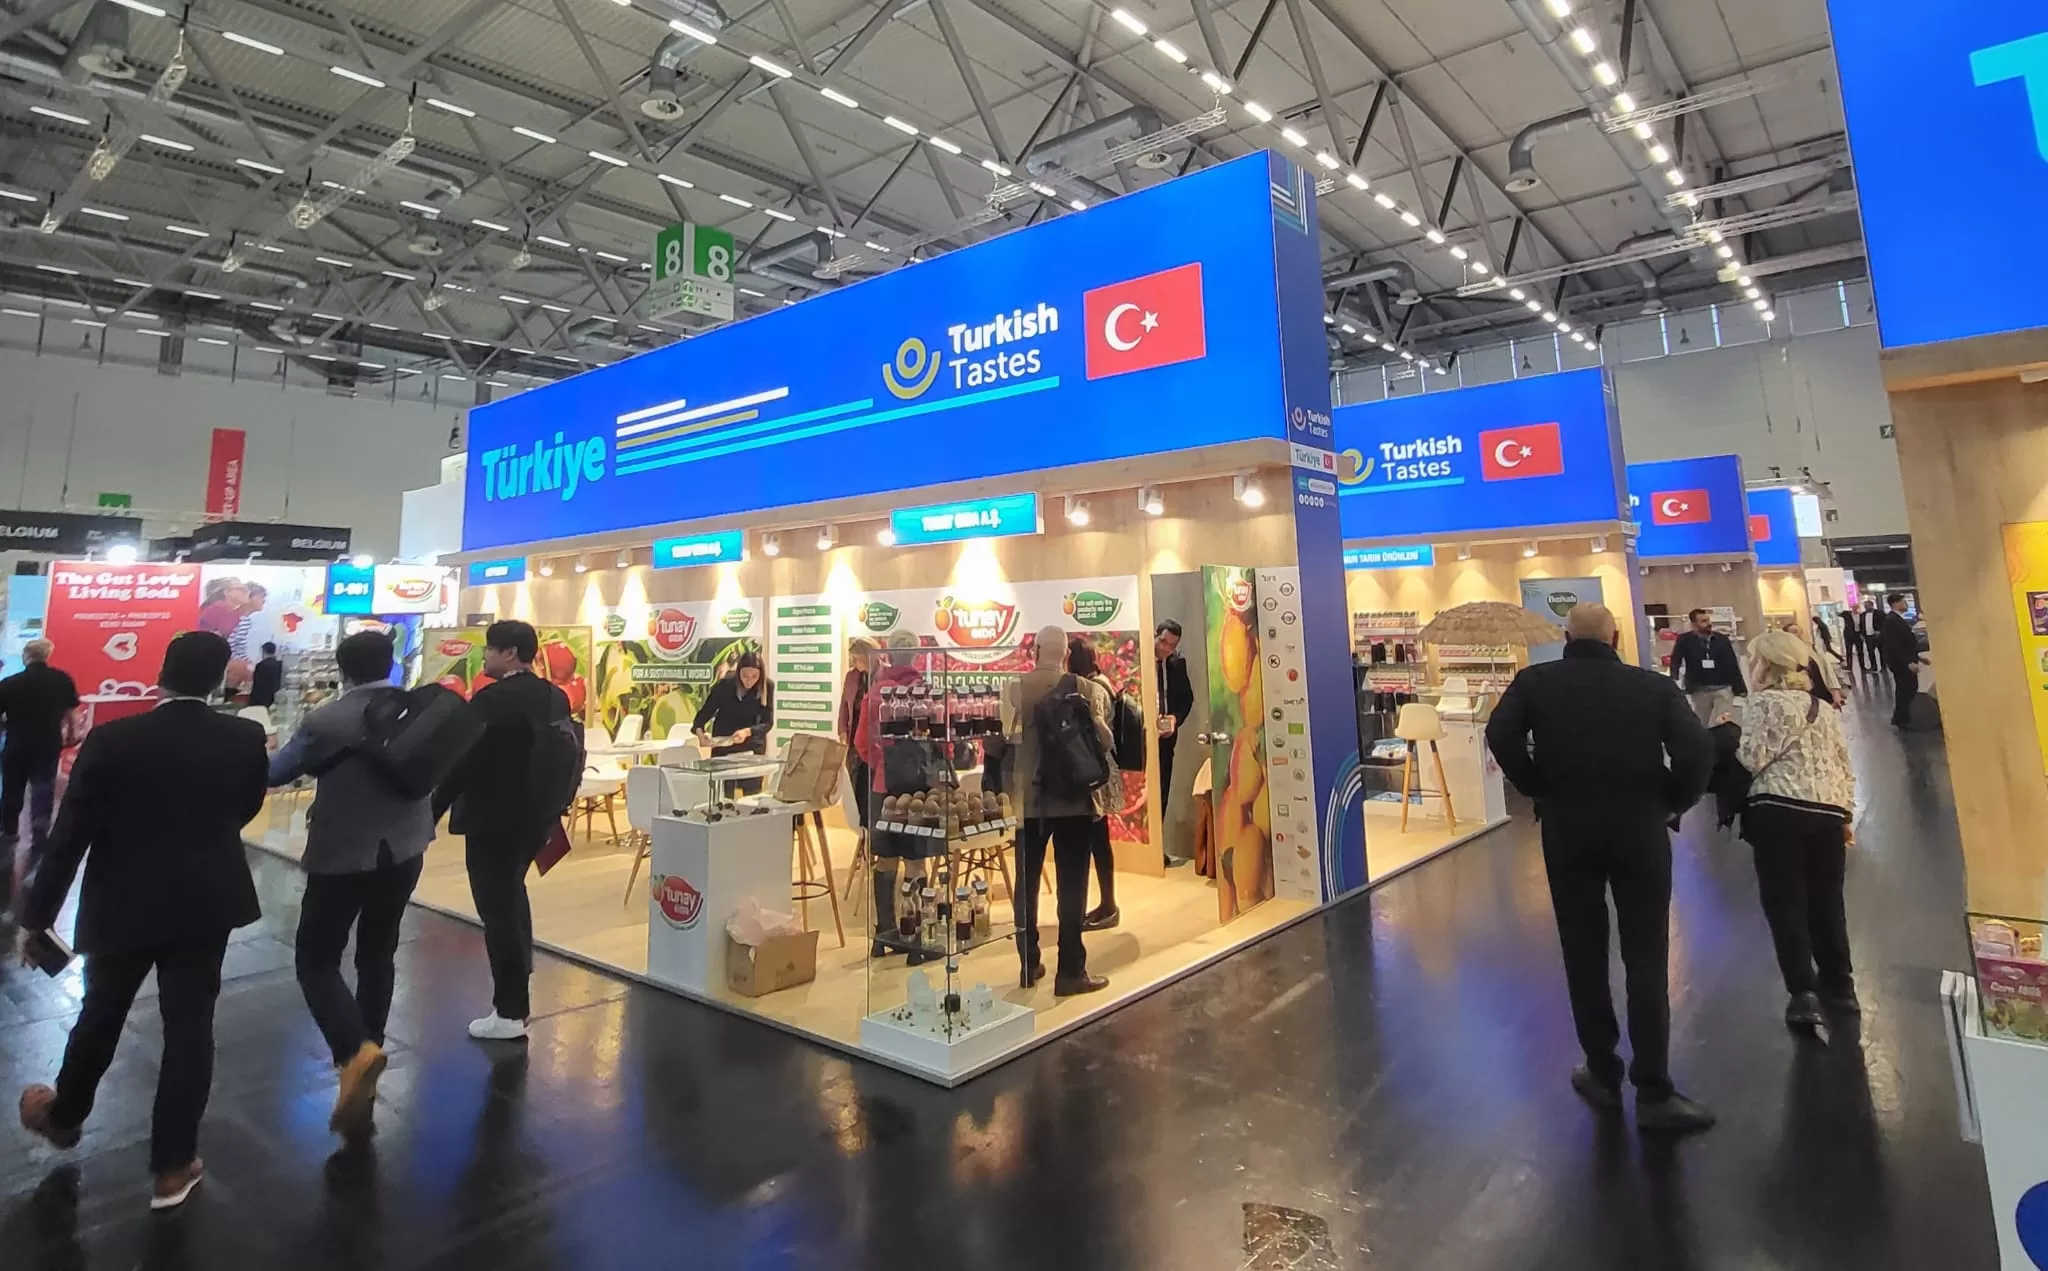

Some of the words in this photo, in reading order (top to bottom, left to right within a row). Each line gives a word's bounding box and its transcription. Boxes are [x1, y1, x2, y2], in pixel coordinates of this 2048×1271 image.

[665, 240, 681, 277] 8
[707, 245, 730, 282] 8
[948, 302, 1059, 355] Turkish
[948, 348, 1041, 389] Tastes
[1307, 409, 1331, 427] Turkish
[1308, 422, 1329, 438] Tastes
[1295, 448, 1321, 468] Türkiye
[1380, 434, 1463, 461] Turkish
[481, 431, 607, 502] Türkiye
[1380, 458, 1451, 481] Tastes
[0, 525, 59, 538] ELGIUM
[291, 538, 347, 550] BELGIUM
[55, 571, 93, 585] The
[96, 572, 134, 585] Gut
[68, 586, 132, 601] Living
[134, 586, 180, 599] Soda
